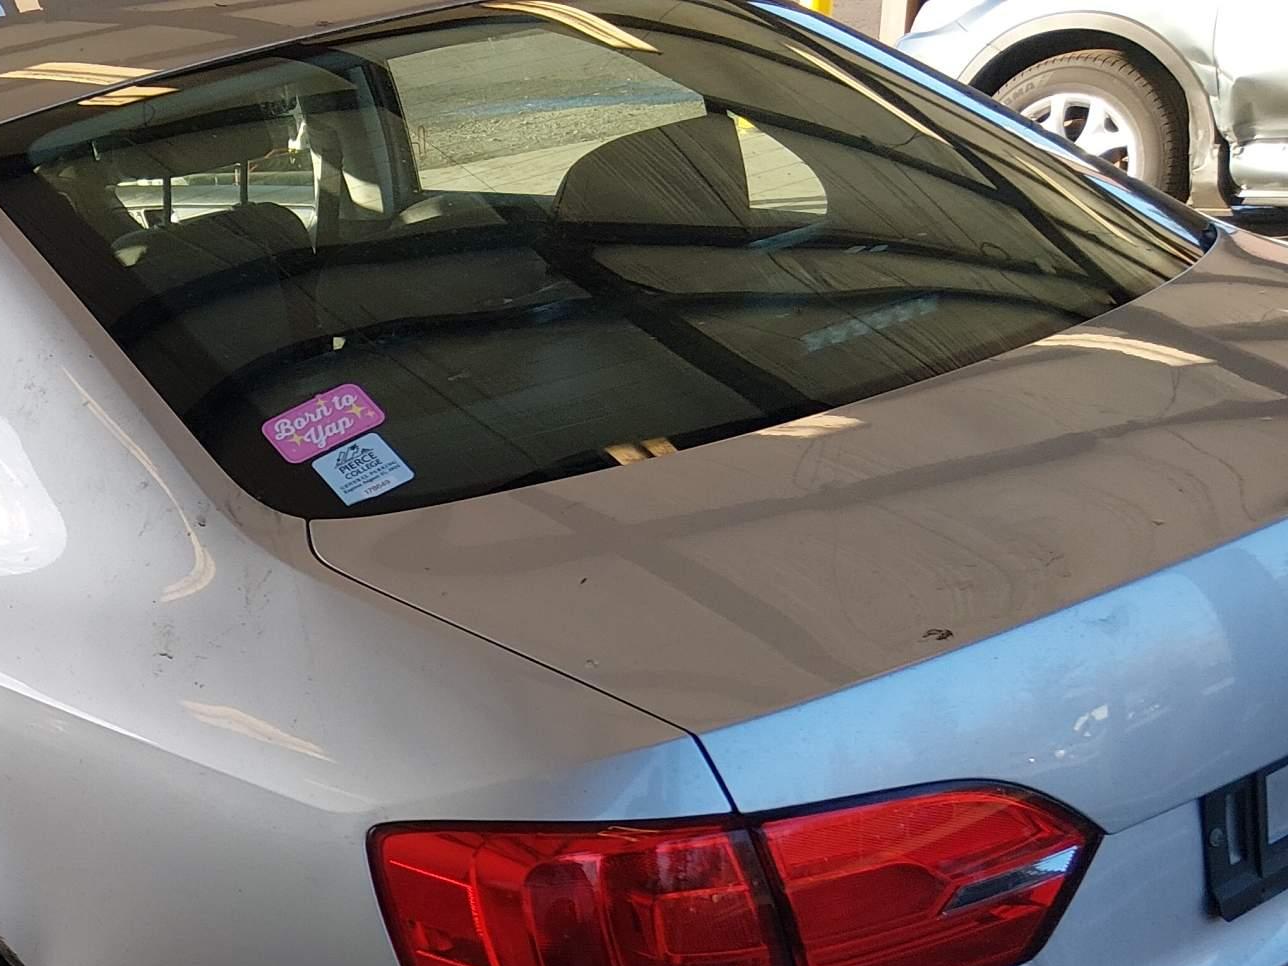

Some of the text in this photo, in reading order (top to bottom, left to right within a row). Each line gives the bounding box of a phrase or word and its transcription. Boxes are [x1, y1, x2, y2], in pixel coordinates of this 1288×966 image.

[274, 394, 358, 440] Born to
[303, 416, 354, 448] Yap
[339, 452, 377, 474] PIERCE
[345, 459, 383, 480] COLLEGE
